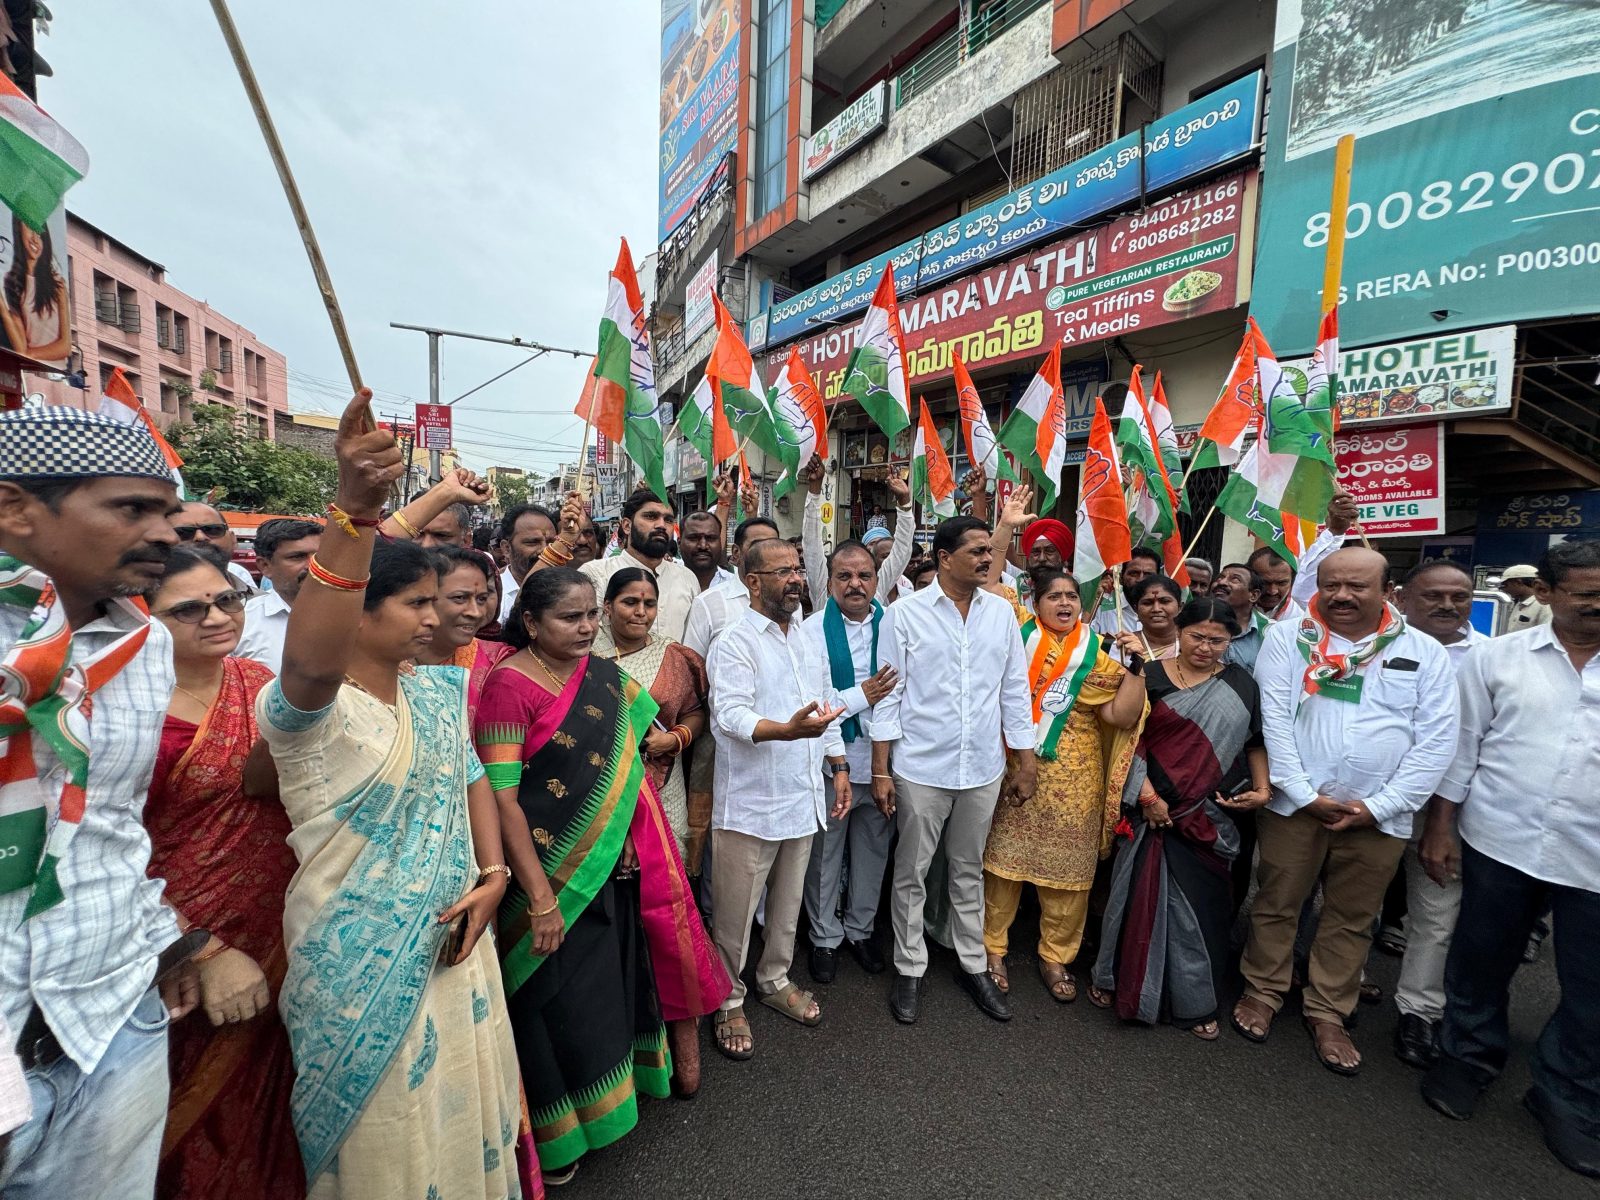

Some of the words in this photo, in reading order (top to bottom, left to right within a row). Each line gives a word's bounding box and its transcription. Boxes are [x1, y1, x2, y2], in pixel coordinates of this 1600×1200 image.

[700, 77, 738, 131] HOTEL
[838, 101, 877, 136] AMARAVATHI
[840, 91, 875, 126] HOTEL
[772, 289, 819, 324] వరంగల్
[820, 271, 853, 303] అర్బన్
[855, 262, 873, 287] కో
[965, 186, 1035, 238] బ్యాంక్
[1174, 99, 1240, 147] బ్రాంచి
[1129, 181, 1238, 234] 9440171166
[1000, 217, 1047, 245] కలదు
[1127, 204, 1236, 254] 8008682282
[1067, 285, 1089, 300] PURE
[1092, 266, 1152, 292] VEGETARIAN
[1155, 242, 1229, 273] RESTAURANT
[1356, 270, 1432, 302] RERA
[1439, 262, 1486, 286] No:
[1497, 242, 1600, 276] P00300
[813, 324, 862, 364] HOTE
[899, 237, 1097, 334] MARAVATHI
[1054, 303, 1088, 327] Tea
[1092, 288, 1155, 316] Tiffins
[1063, 329, 1076, 344] &
[1080, 312, 1140, 341] Meals
[1344, 334, 1489, 377] HOTEL
[1337, 360, 1497, 394] AMARAVATHI
[1352, 493, 1383, 502] ROOMS
[1385, 489, 1433, 500] AVAILABLE
[1368, 480, 1379, 489] &
[1383, 503, 1419, 518] VEG
[1326, 680, 1357, 690] CONGRESS
